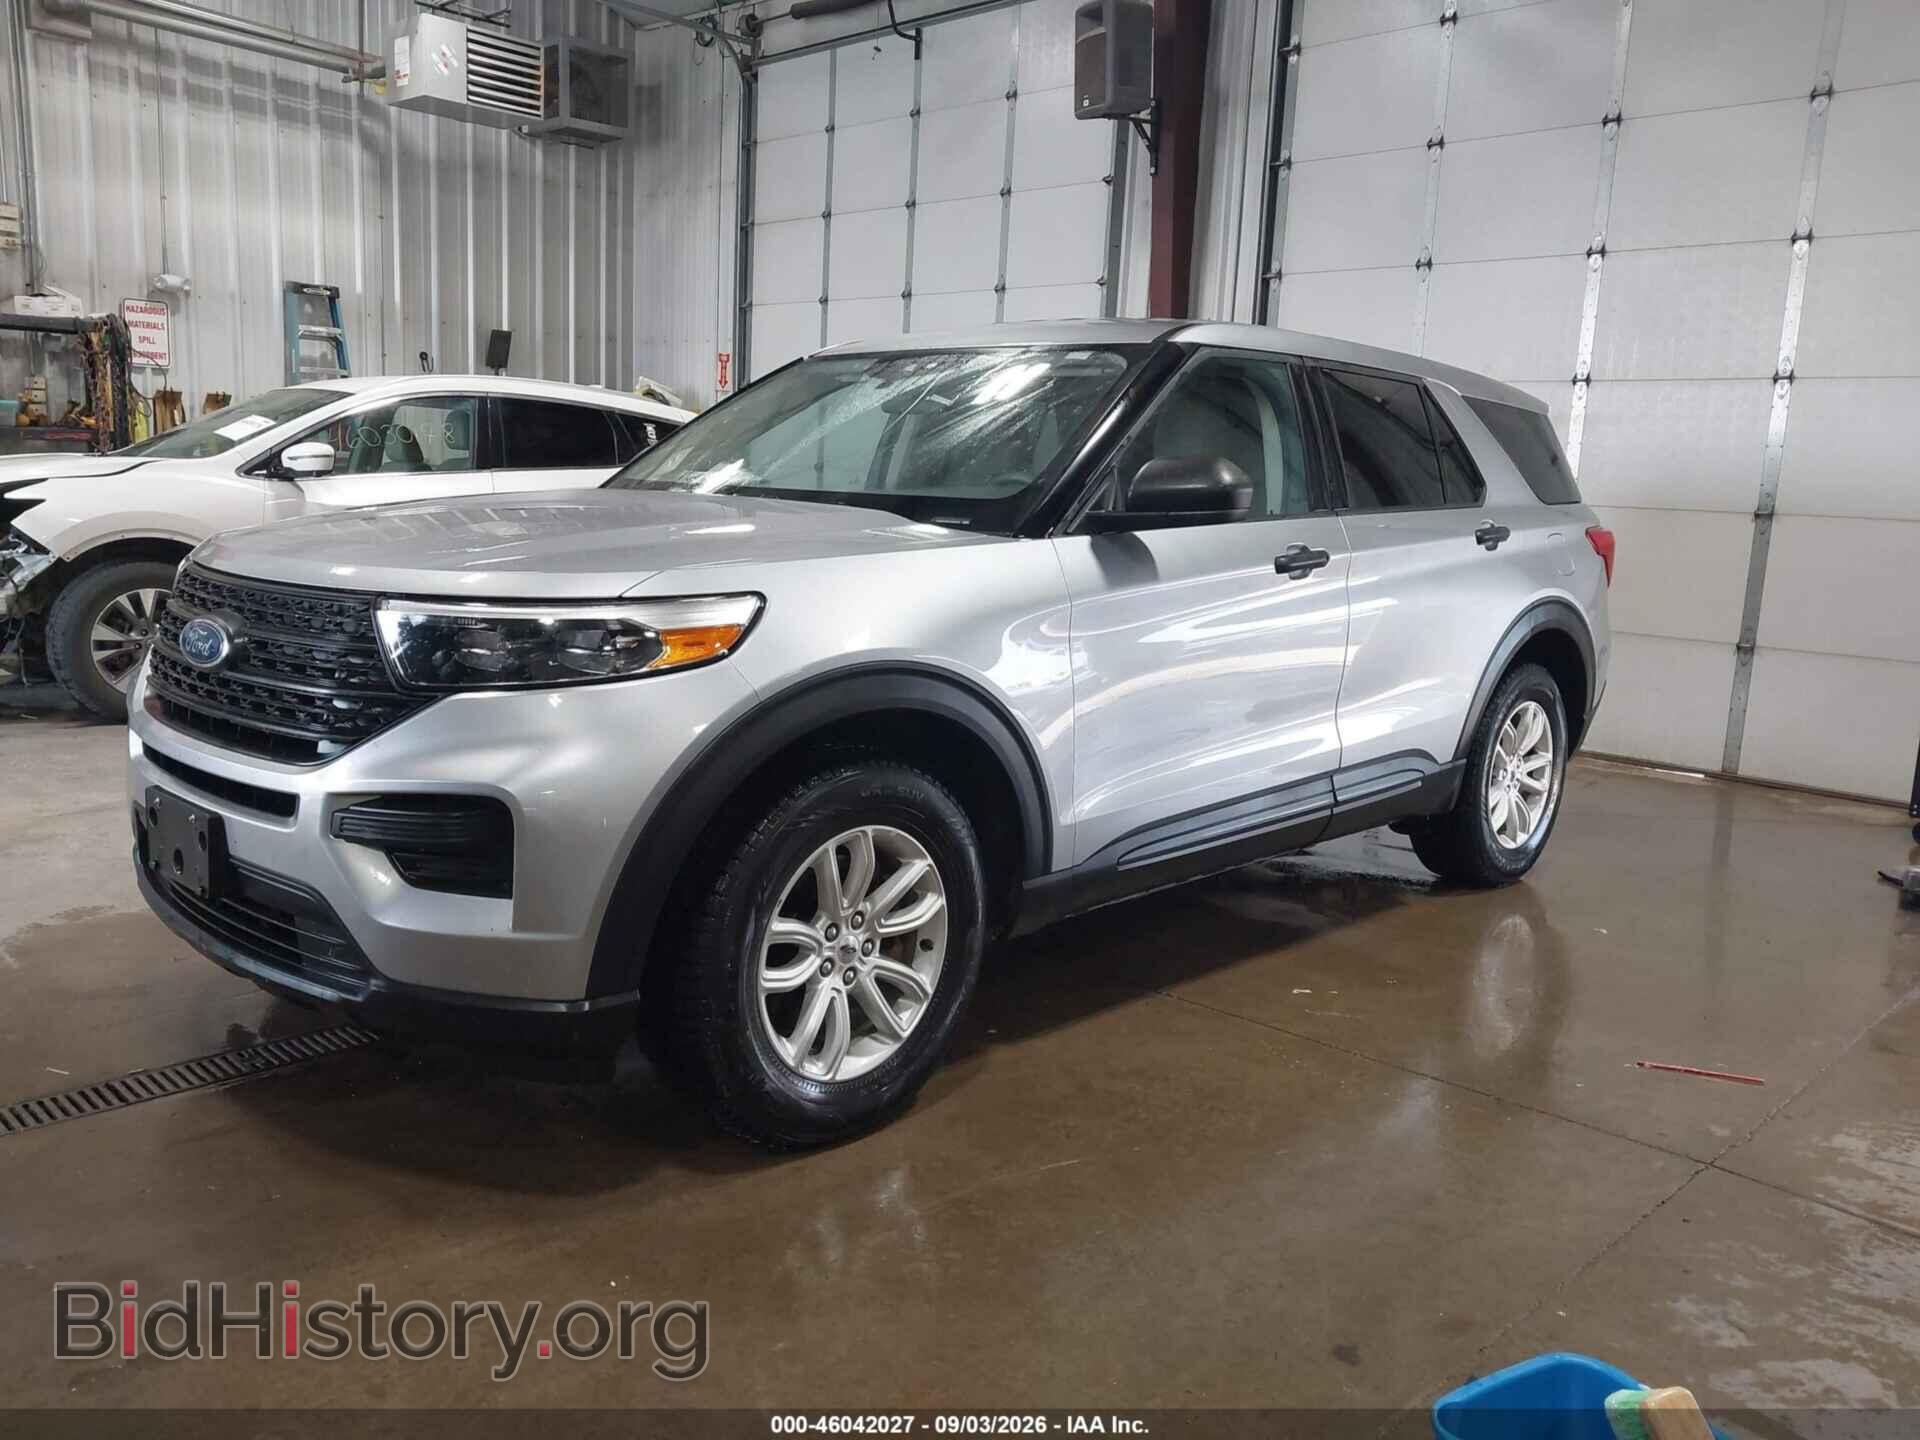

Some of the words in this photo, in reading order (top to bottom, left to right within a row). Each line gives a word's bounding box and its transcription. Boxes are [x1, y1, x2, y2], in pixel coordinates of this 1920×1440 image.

[126, 304, 166, 316] HAZARDOUS
[128, 320, 165, 331] MATERIALS
[138, 335, 157, 345] SPILL
[185, 627, 214, 657] Ford
